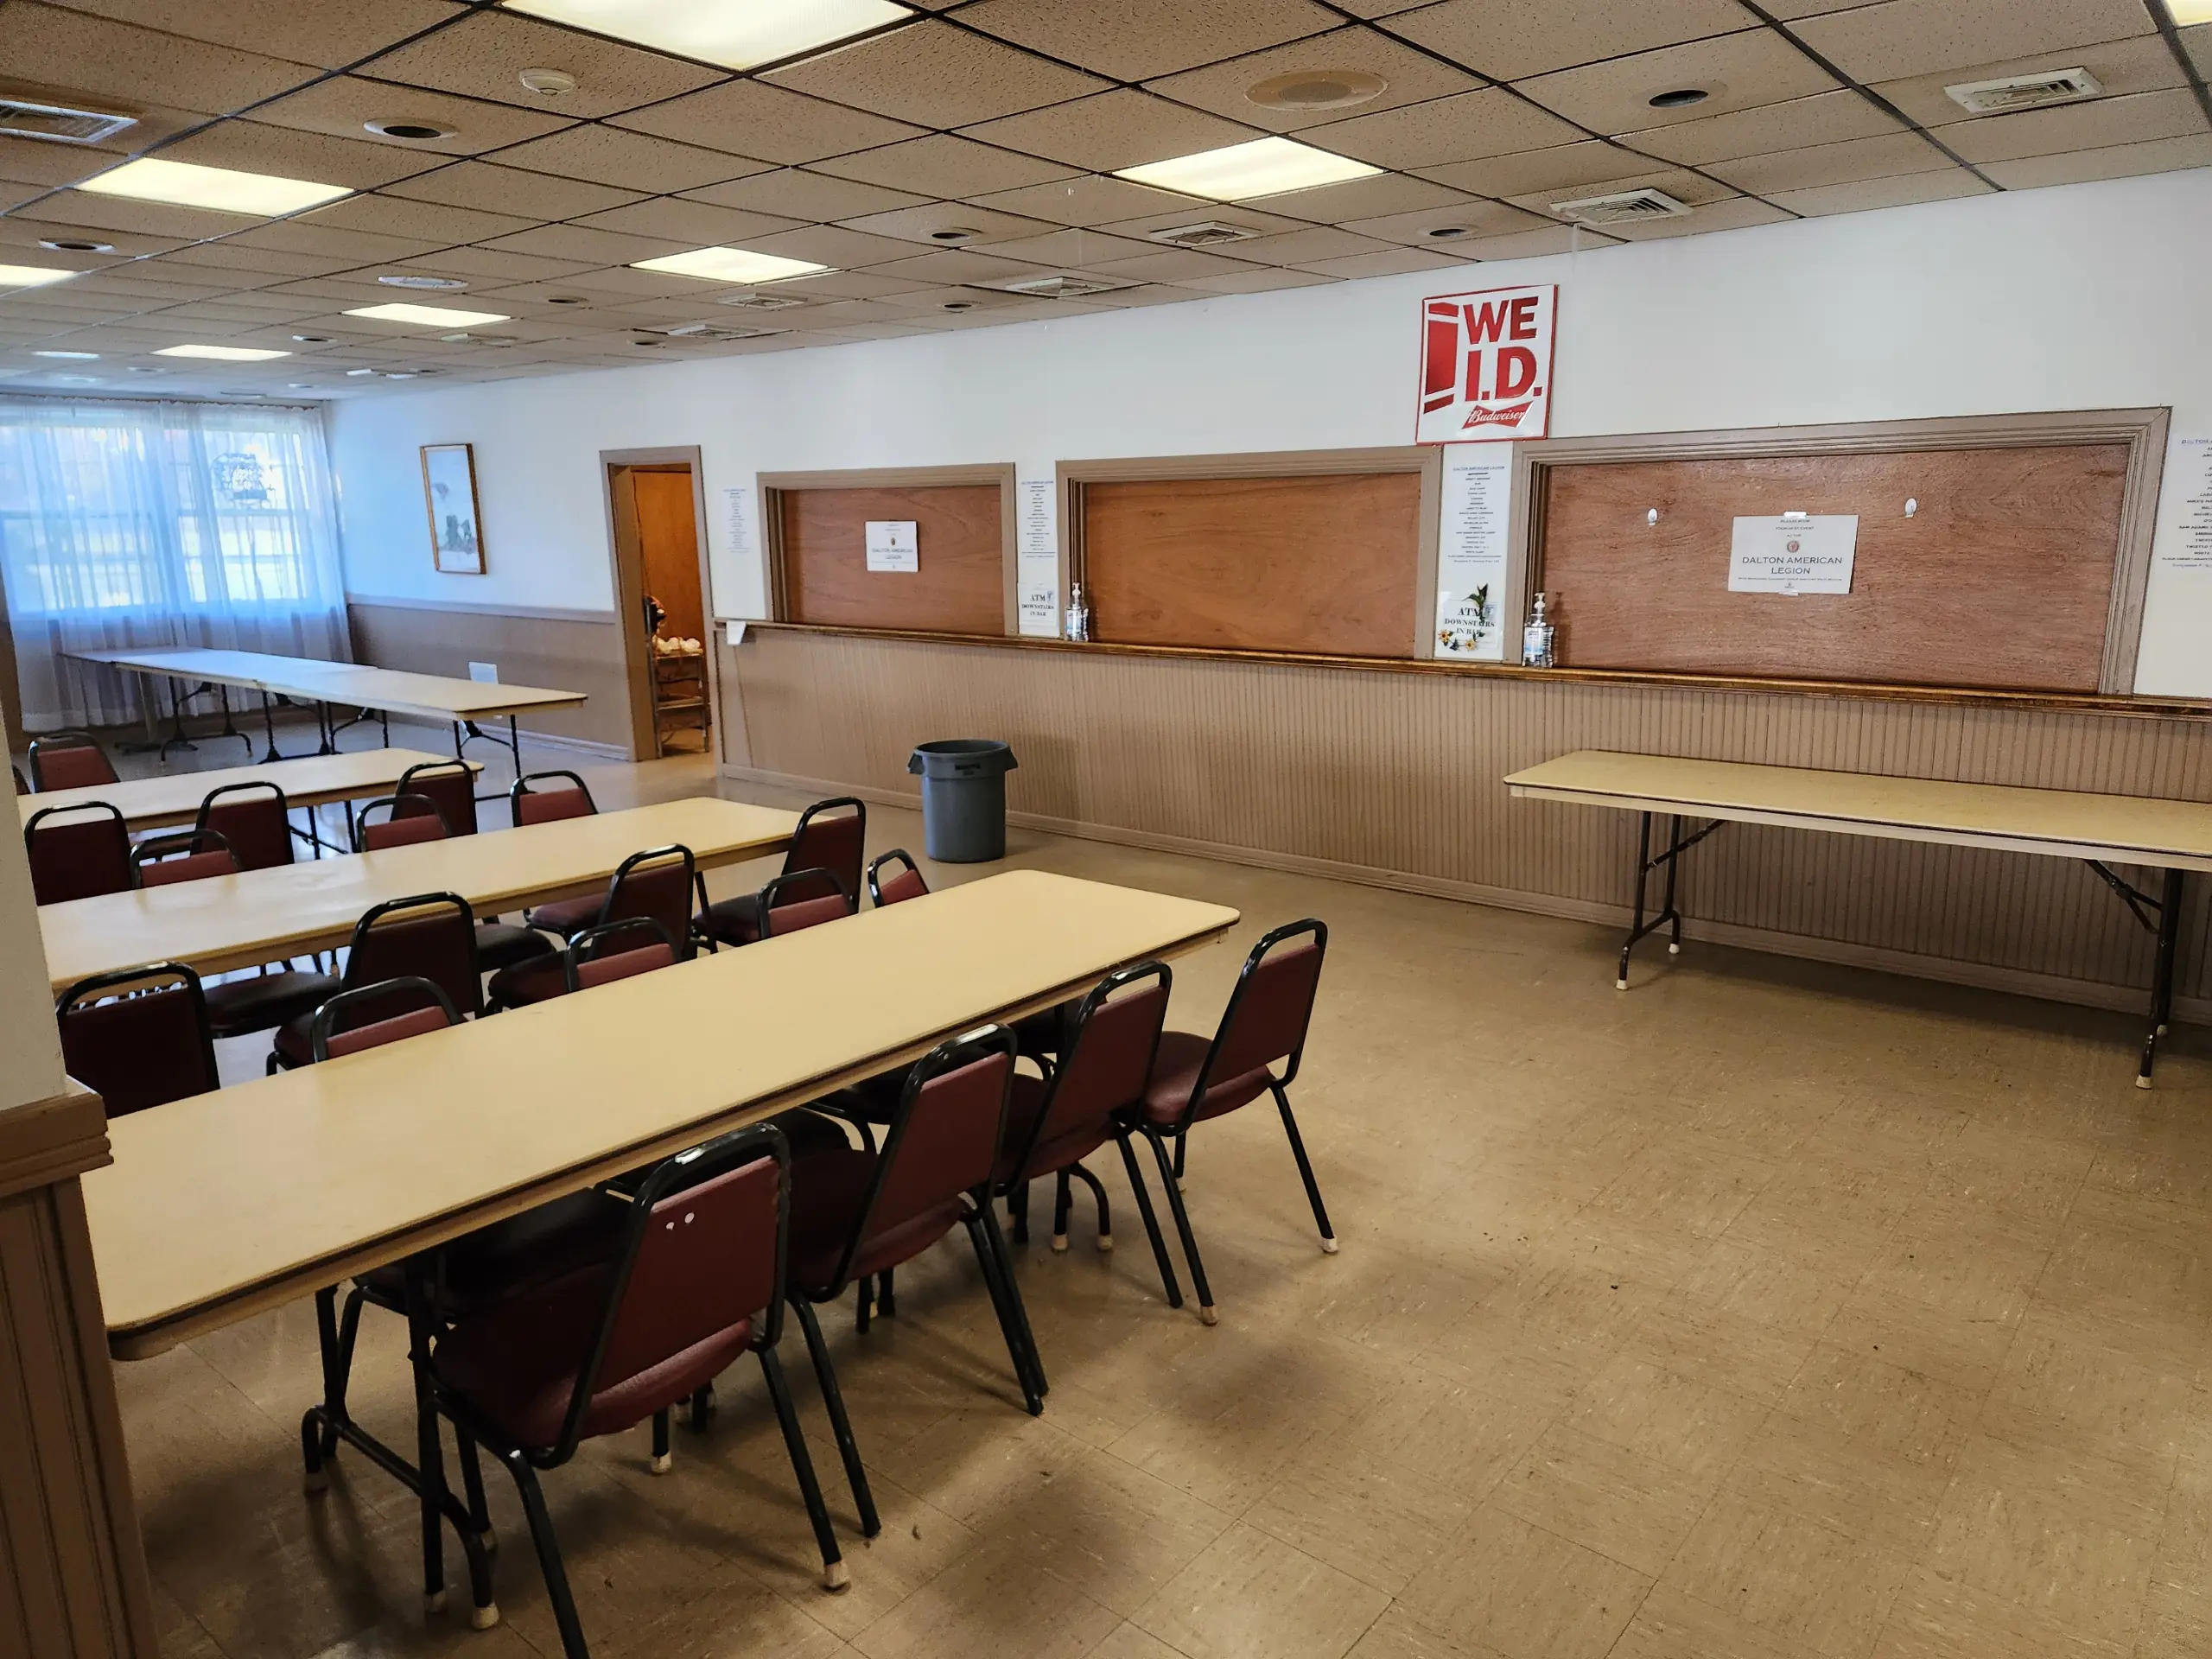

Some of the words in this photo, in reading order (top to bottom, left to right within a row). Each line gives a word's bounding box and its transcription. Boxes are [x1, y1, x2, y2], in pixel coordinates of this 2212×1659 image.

[1463, 296, 1539, 345] WE
[1465, 346, 1543, 402] I.D.
[1467, 409, 1527, 423] Budweiser
[1458, 607, 1481, 617] ATM
